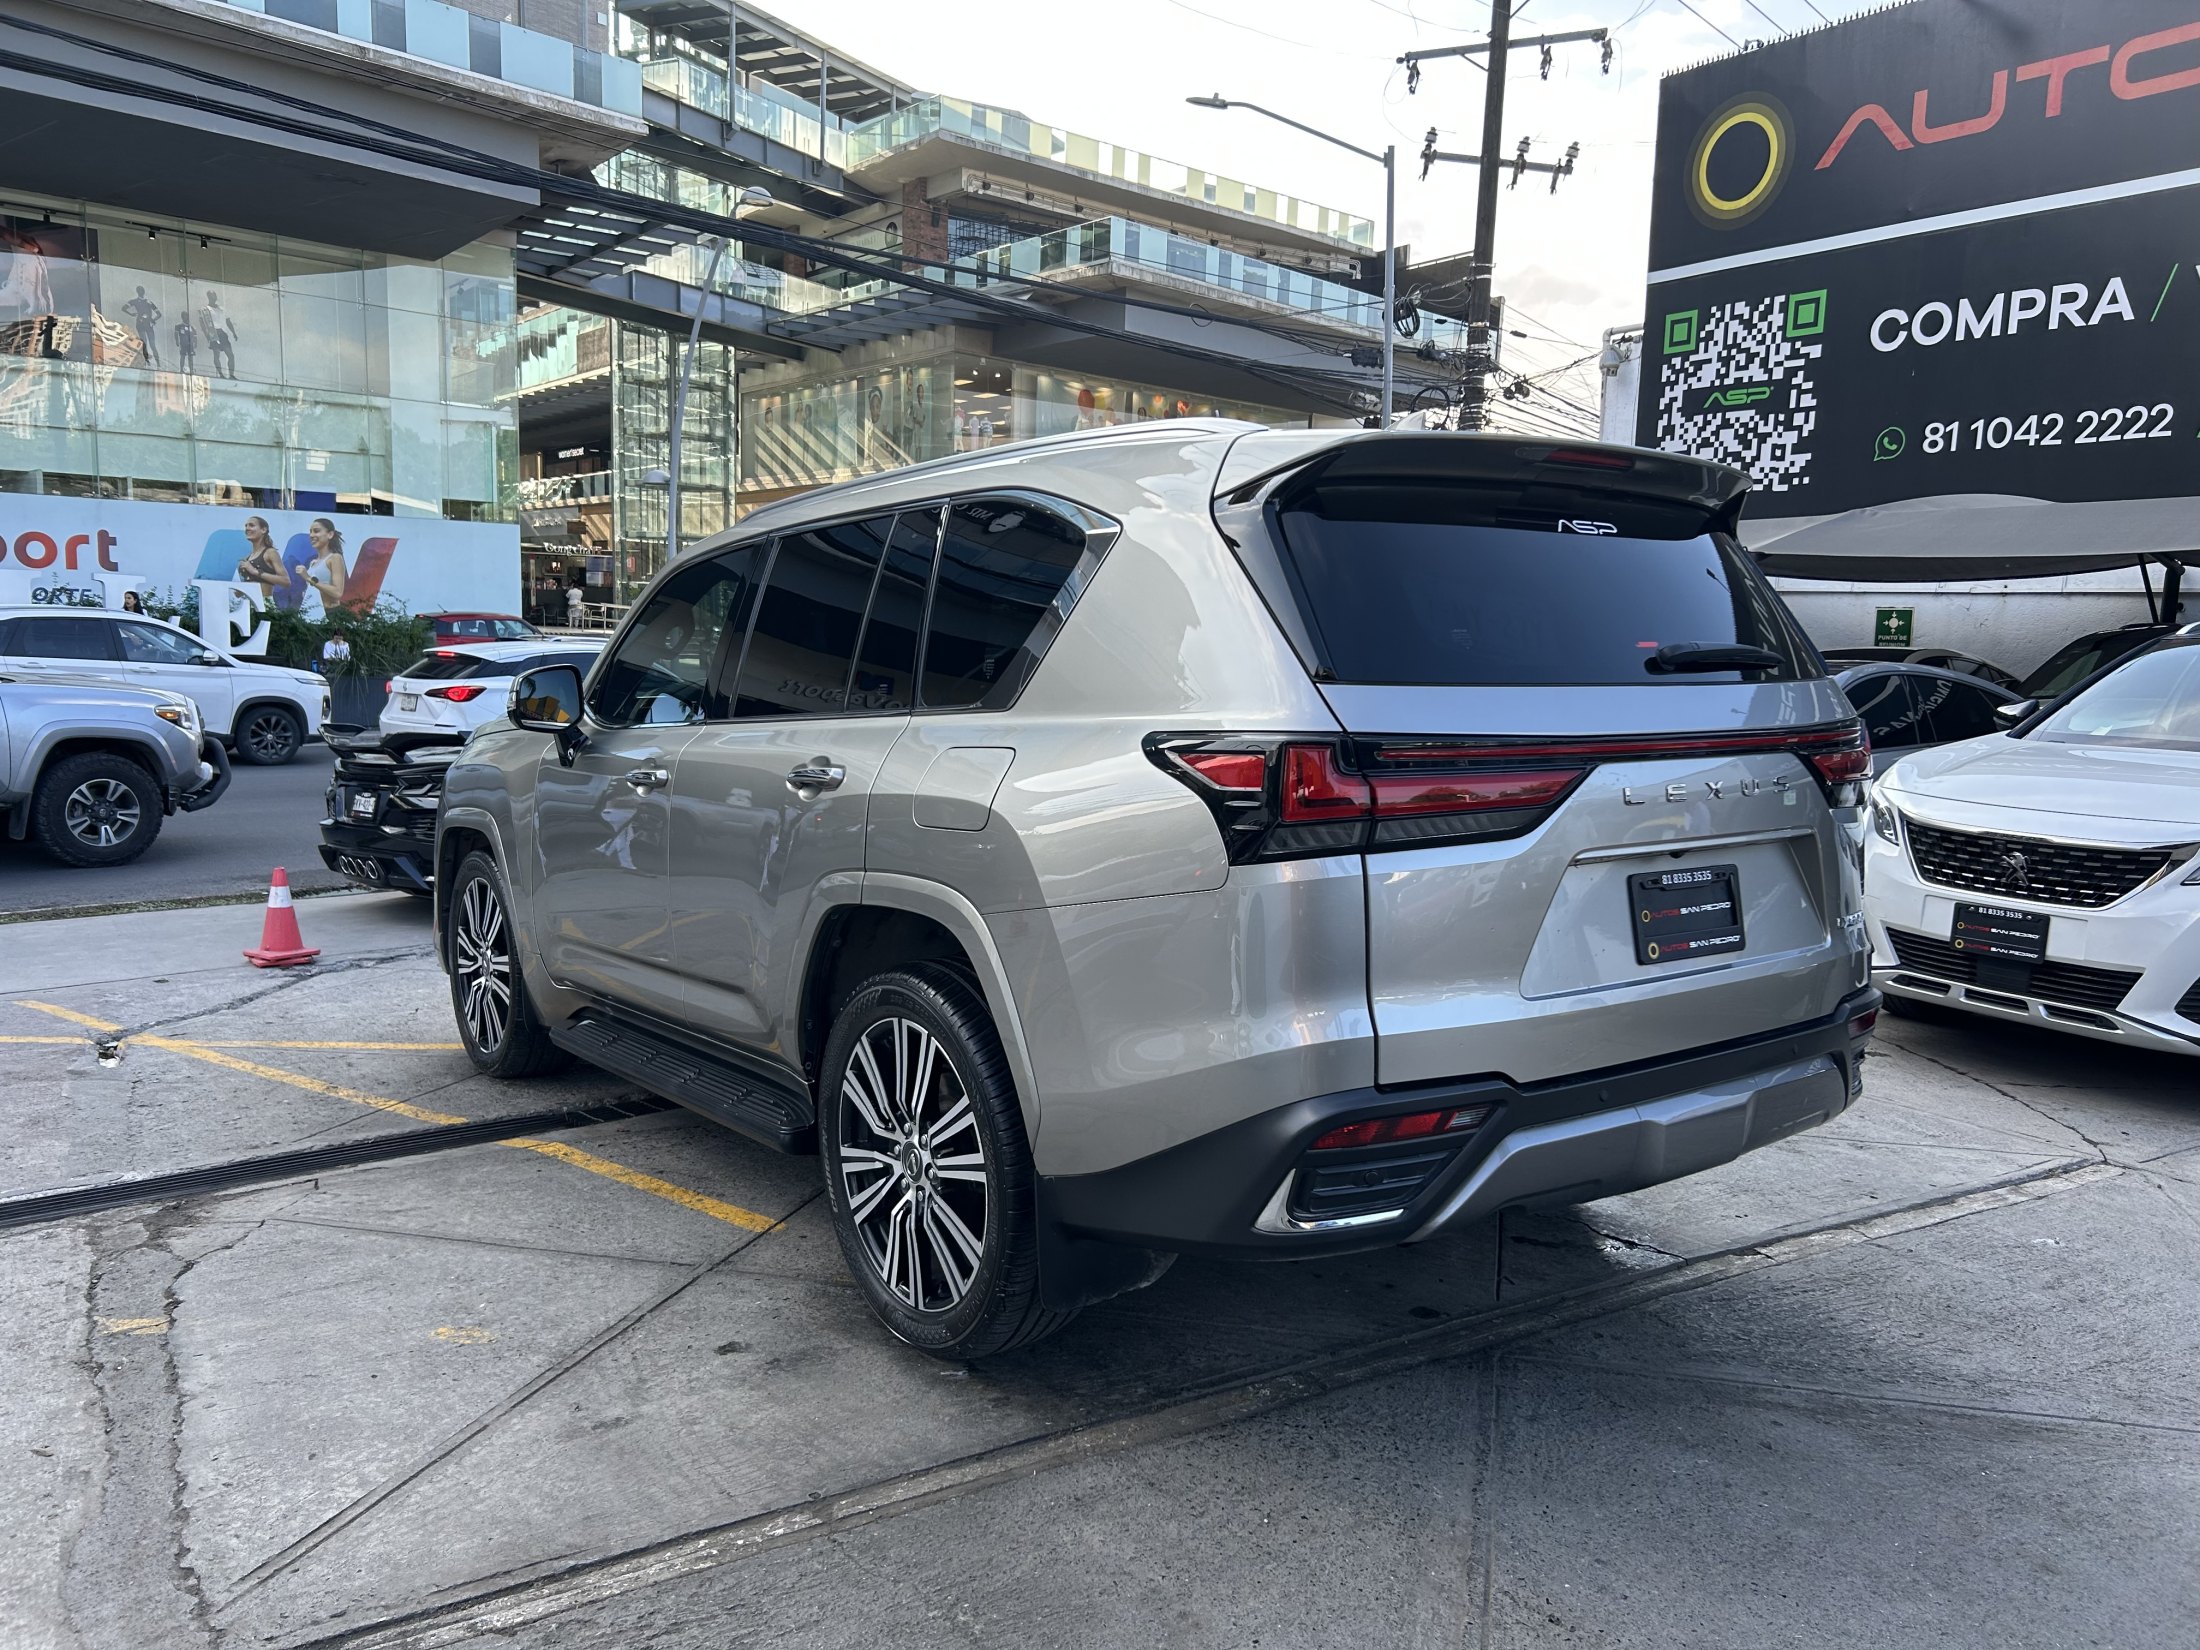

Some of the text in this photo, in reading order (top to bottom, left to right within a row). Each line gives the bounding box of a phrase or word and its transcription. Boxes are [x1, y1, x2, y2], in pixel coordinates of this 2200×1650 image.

[1869, 276, 2135, 352] COMPRA
[1703, 386, 1770, 408] ASP
[1922, 403, 2174, 453] 81 1042 2222
[0, 529, 119, 573] ort
[1622, 775, 1790, 806] LEXUS
[1662, 870, 1712, 884] 81 8335 3535
[1651, 901, 1732, 918] AUTOS SAN PEDRO
[1988, 908, 2005, 917] 8335
[2005, 910, 2023, 919] 3535
[1660, 935, 1741, 952] AUTOS SAN PEDRO
